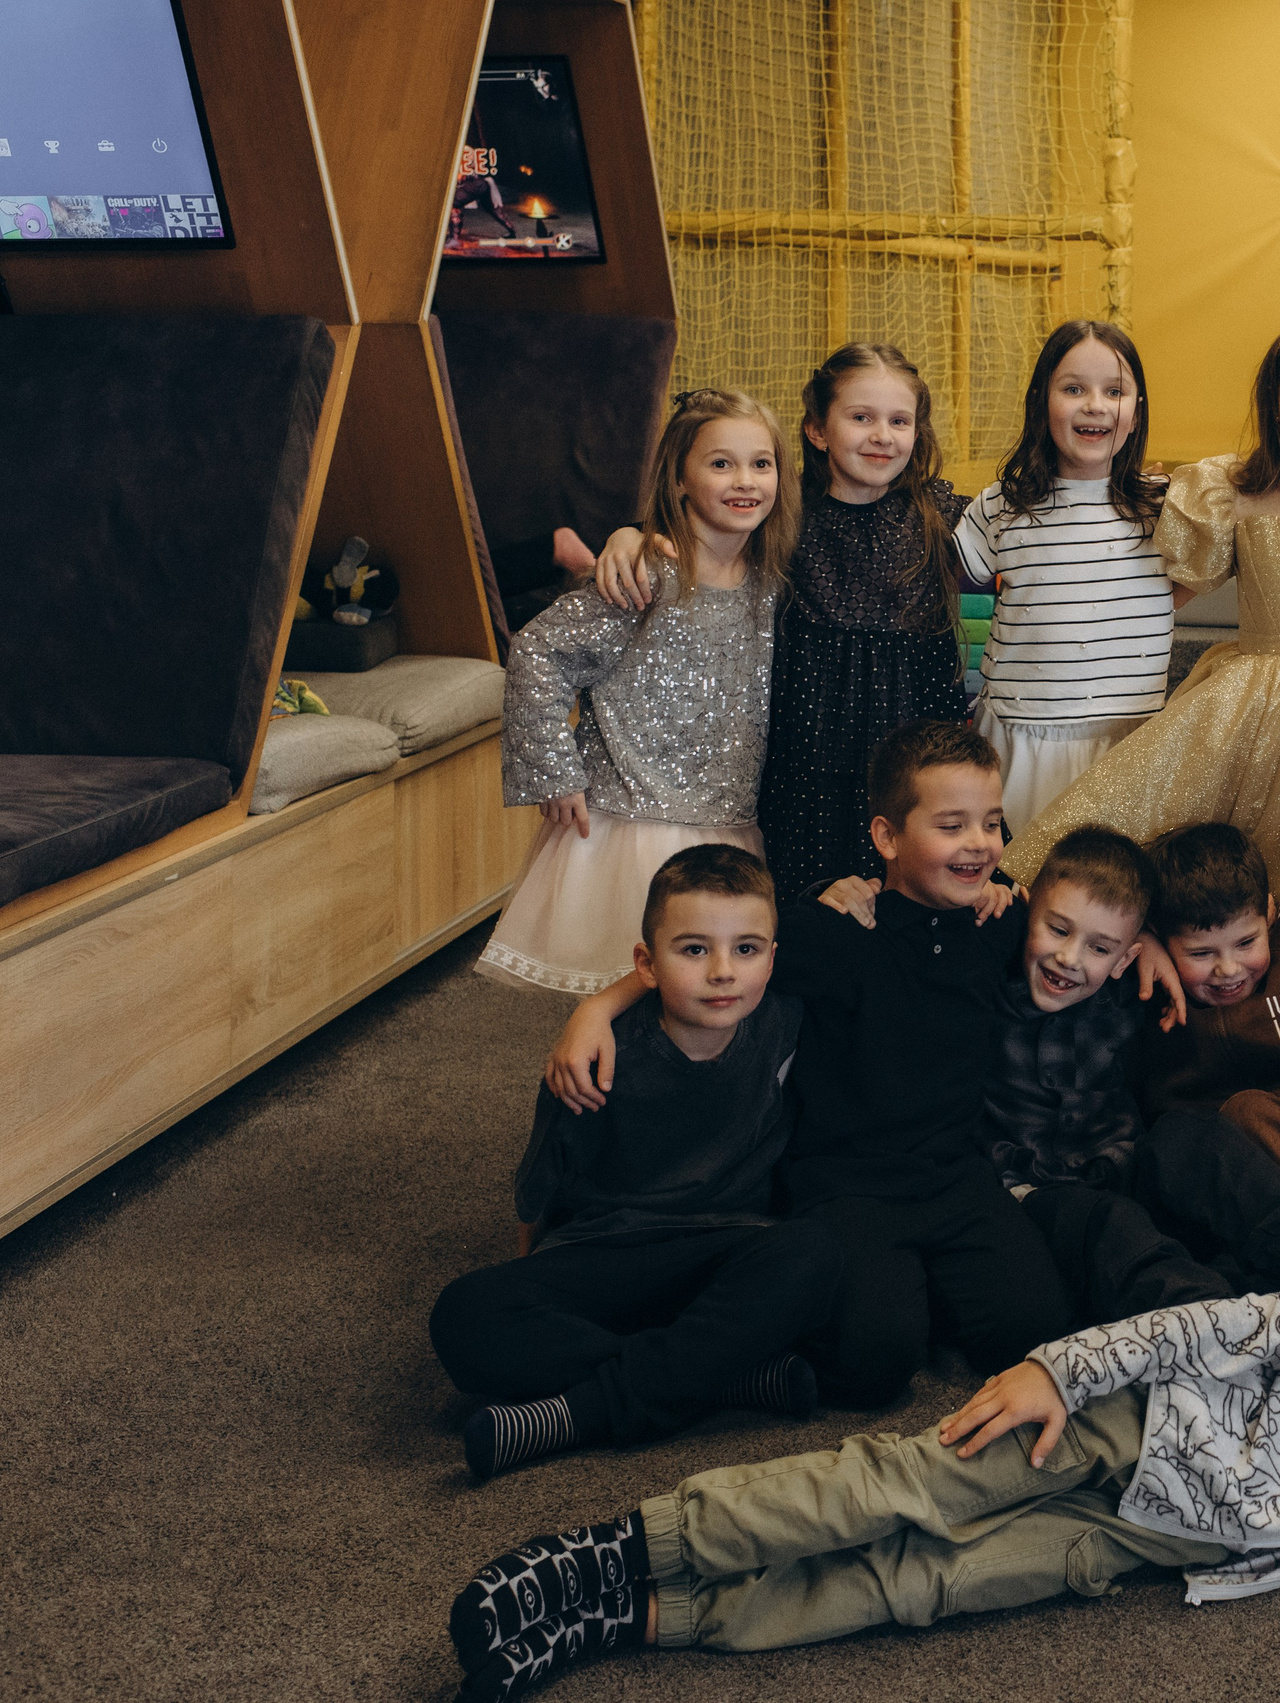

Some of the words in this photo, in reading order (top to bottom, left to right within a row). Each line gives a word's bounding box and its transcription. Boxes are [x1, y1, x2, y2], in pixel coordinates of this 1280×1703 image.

[107, 197, 130, 207] CALL
[161, 195, 214, 212] LET
[188, 213, 219, 225] IT
